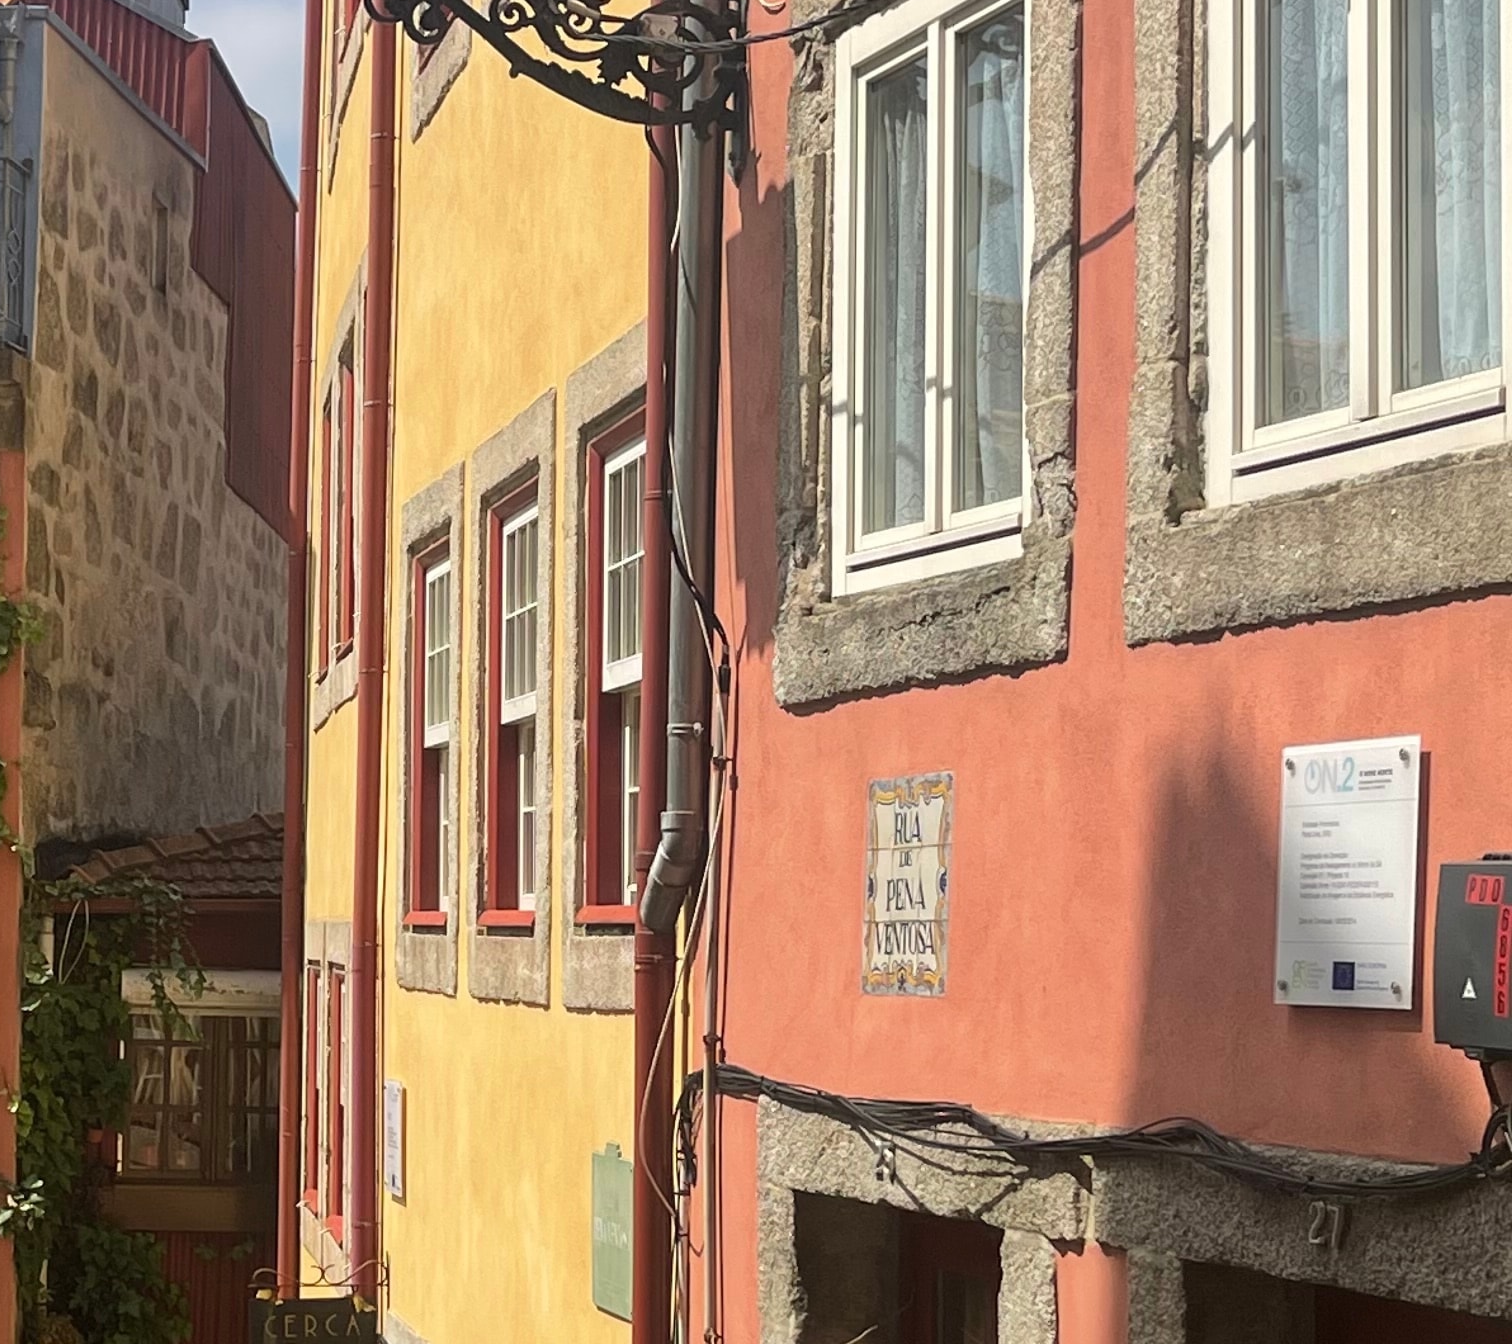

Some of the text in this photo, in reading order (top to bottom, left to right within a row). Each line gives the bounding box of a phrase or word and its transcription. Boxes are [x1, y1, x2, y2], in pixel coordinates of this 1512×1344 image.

[894, 812, 921, 846] RUA
[899, 850, 914, 867] DE
[886, 878, 926, 912] PENA
[875, 922, 935, 955] VENTOSA
[1309, 1201, 1340, 1248] 27
[264, 1314, 361, 1338] CERCA
